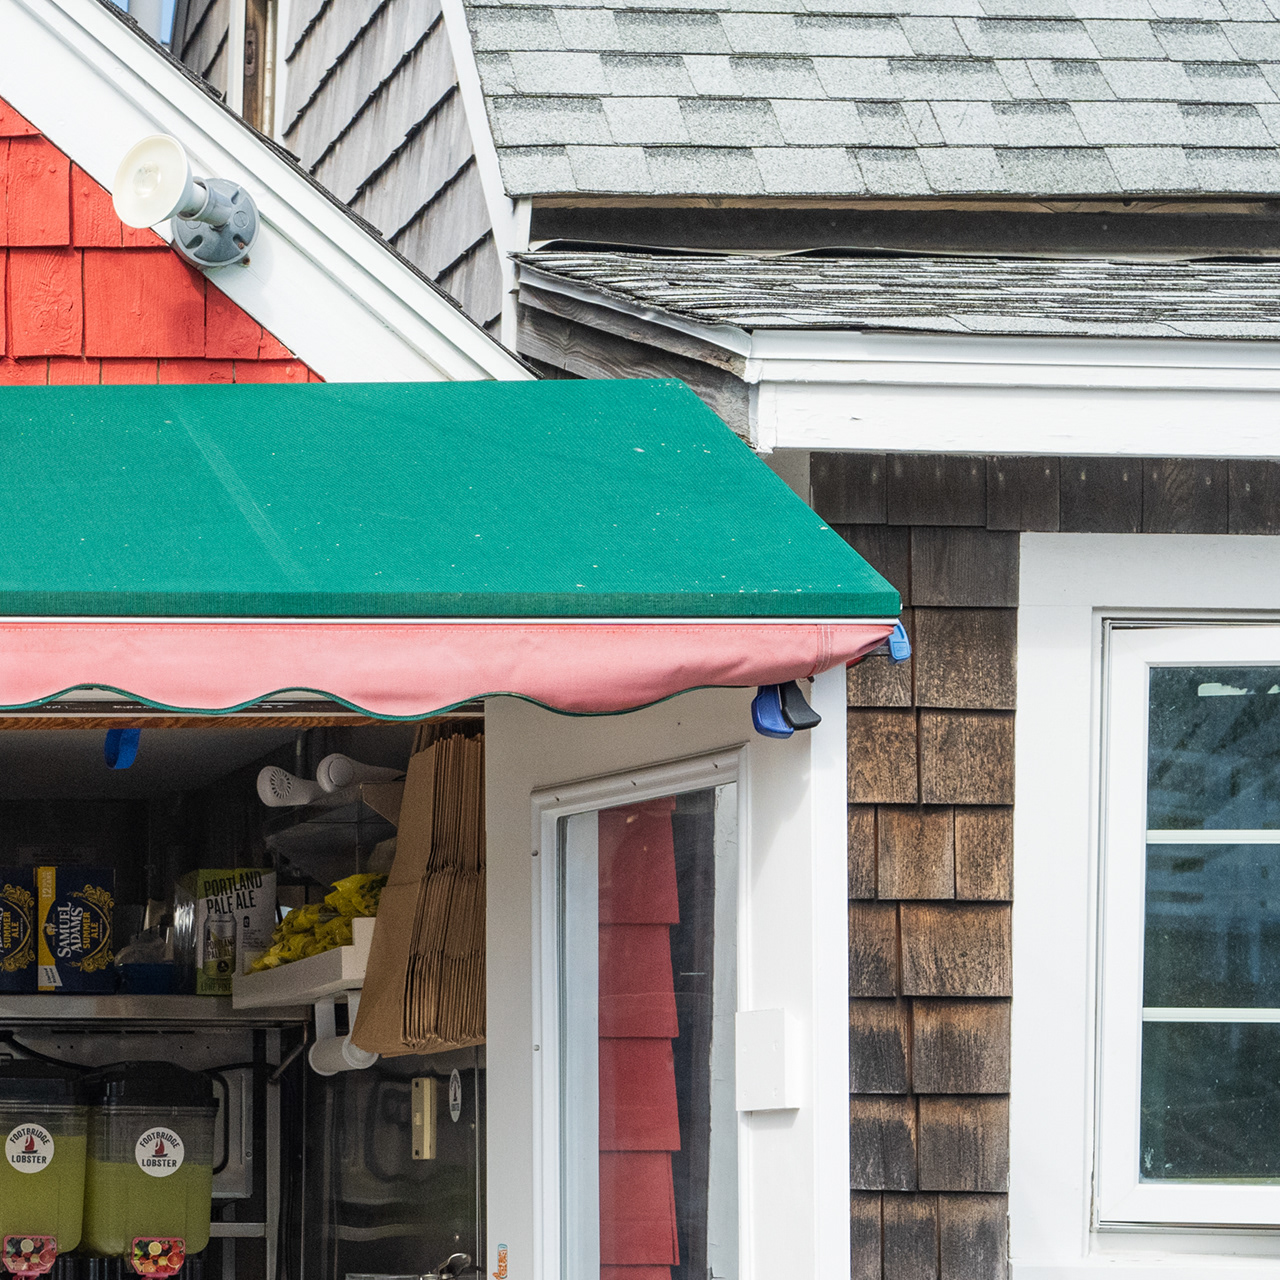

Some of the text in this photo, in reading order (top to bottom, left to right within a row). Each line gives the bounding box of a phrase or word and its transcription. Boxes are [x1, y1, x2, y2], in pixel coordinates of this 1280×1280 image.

[204, 871, 262, 897] PORTLAND
[207, 890, 256, 914] PALE ALE
[11, 922, 19, 938] ALE
[10, 1128, 50, 1145] FOOTBRIDGE
[140, 1132, 180, 1149] FOOTBRIDGE
[12, 1155, 46, 1164] LOBSTER
[142, 1159, 177, 1167] LOBSTER
